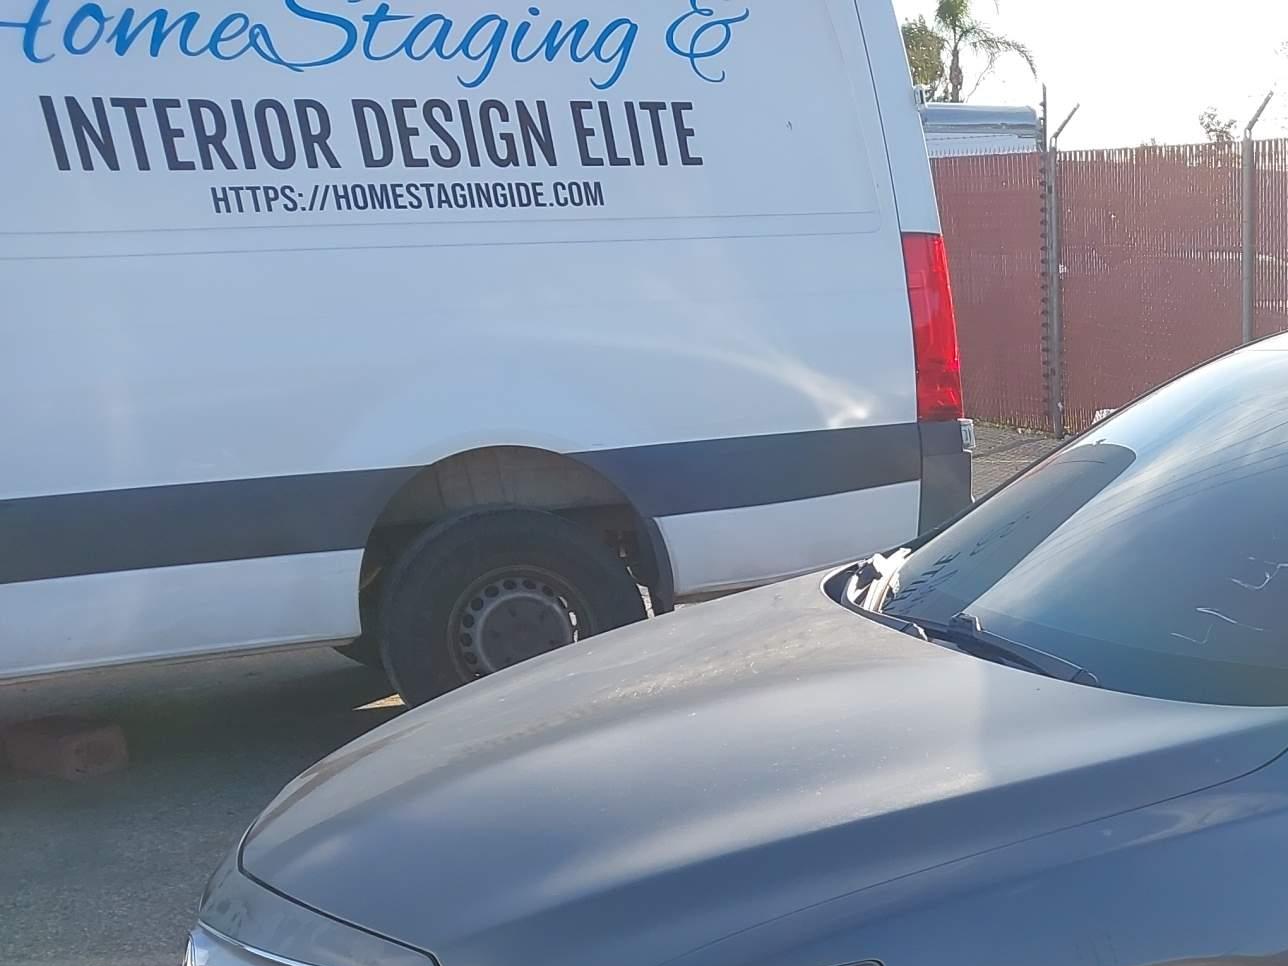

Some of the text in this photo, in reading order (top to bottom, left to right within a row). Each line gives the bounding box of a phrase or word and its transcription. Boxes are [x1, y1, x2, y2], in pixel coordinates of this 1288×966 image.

[38, 95, 704, 172] INTERIOR DESIGN ELITE
[210, 181, 605, 214] HTTPS://HOMESTAGINGIDE.COM
